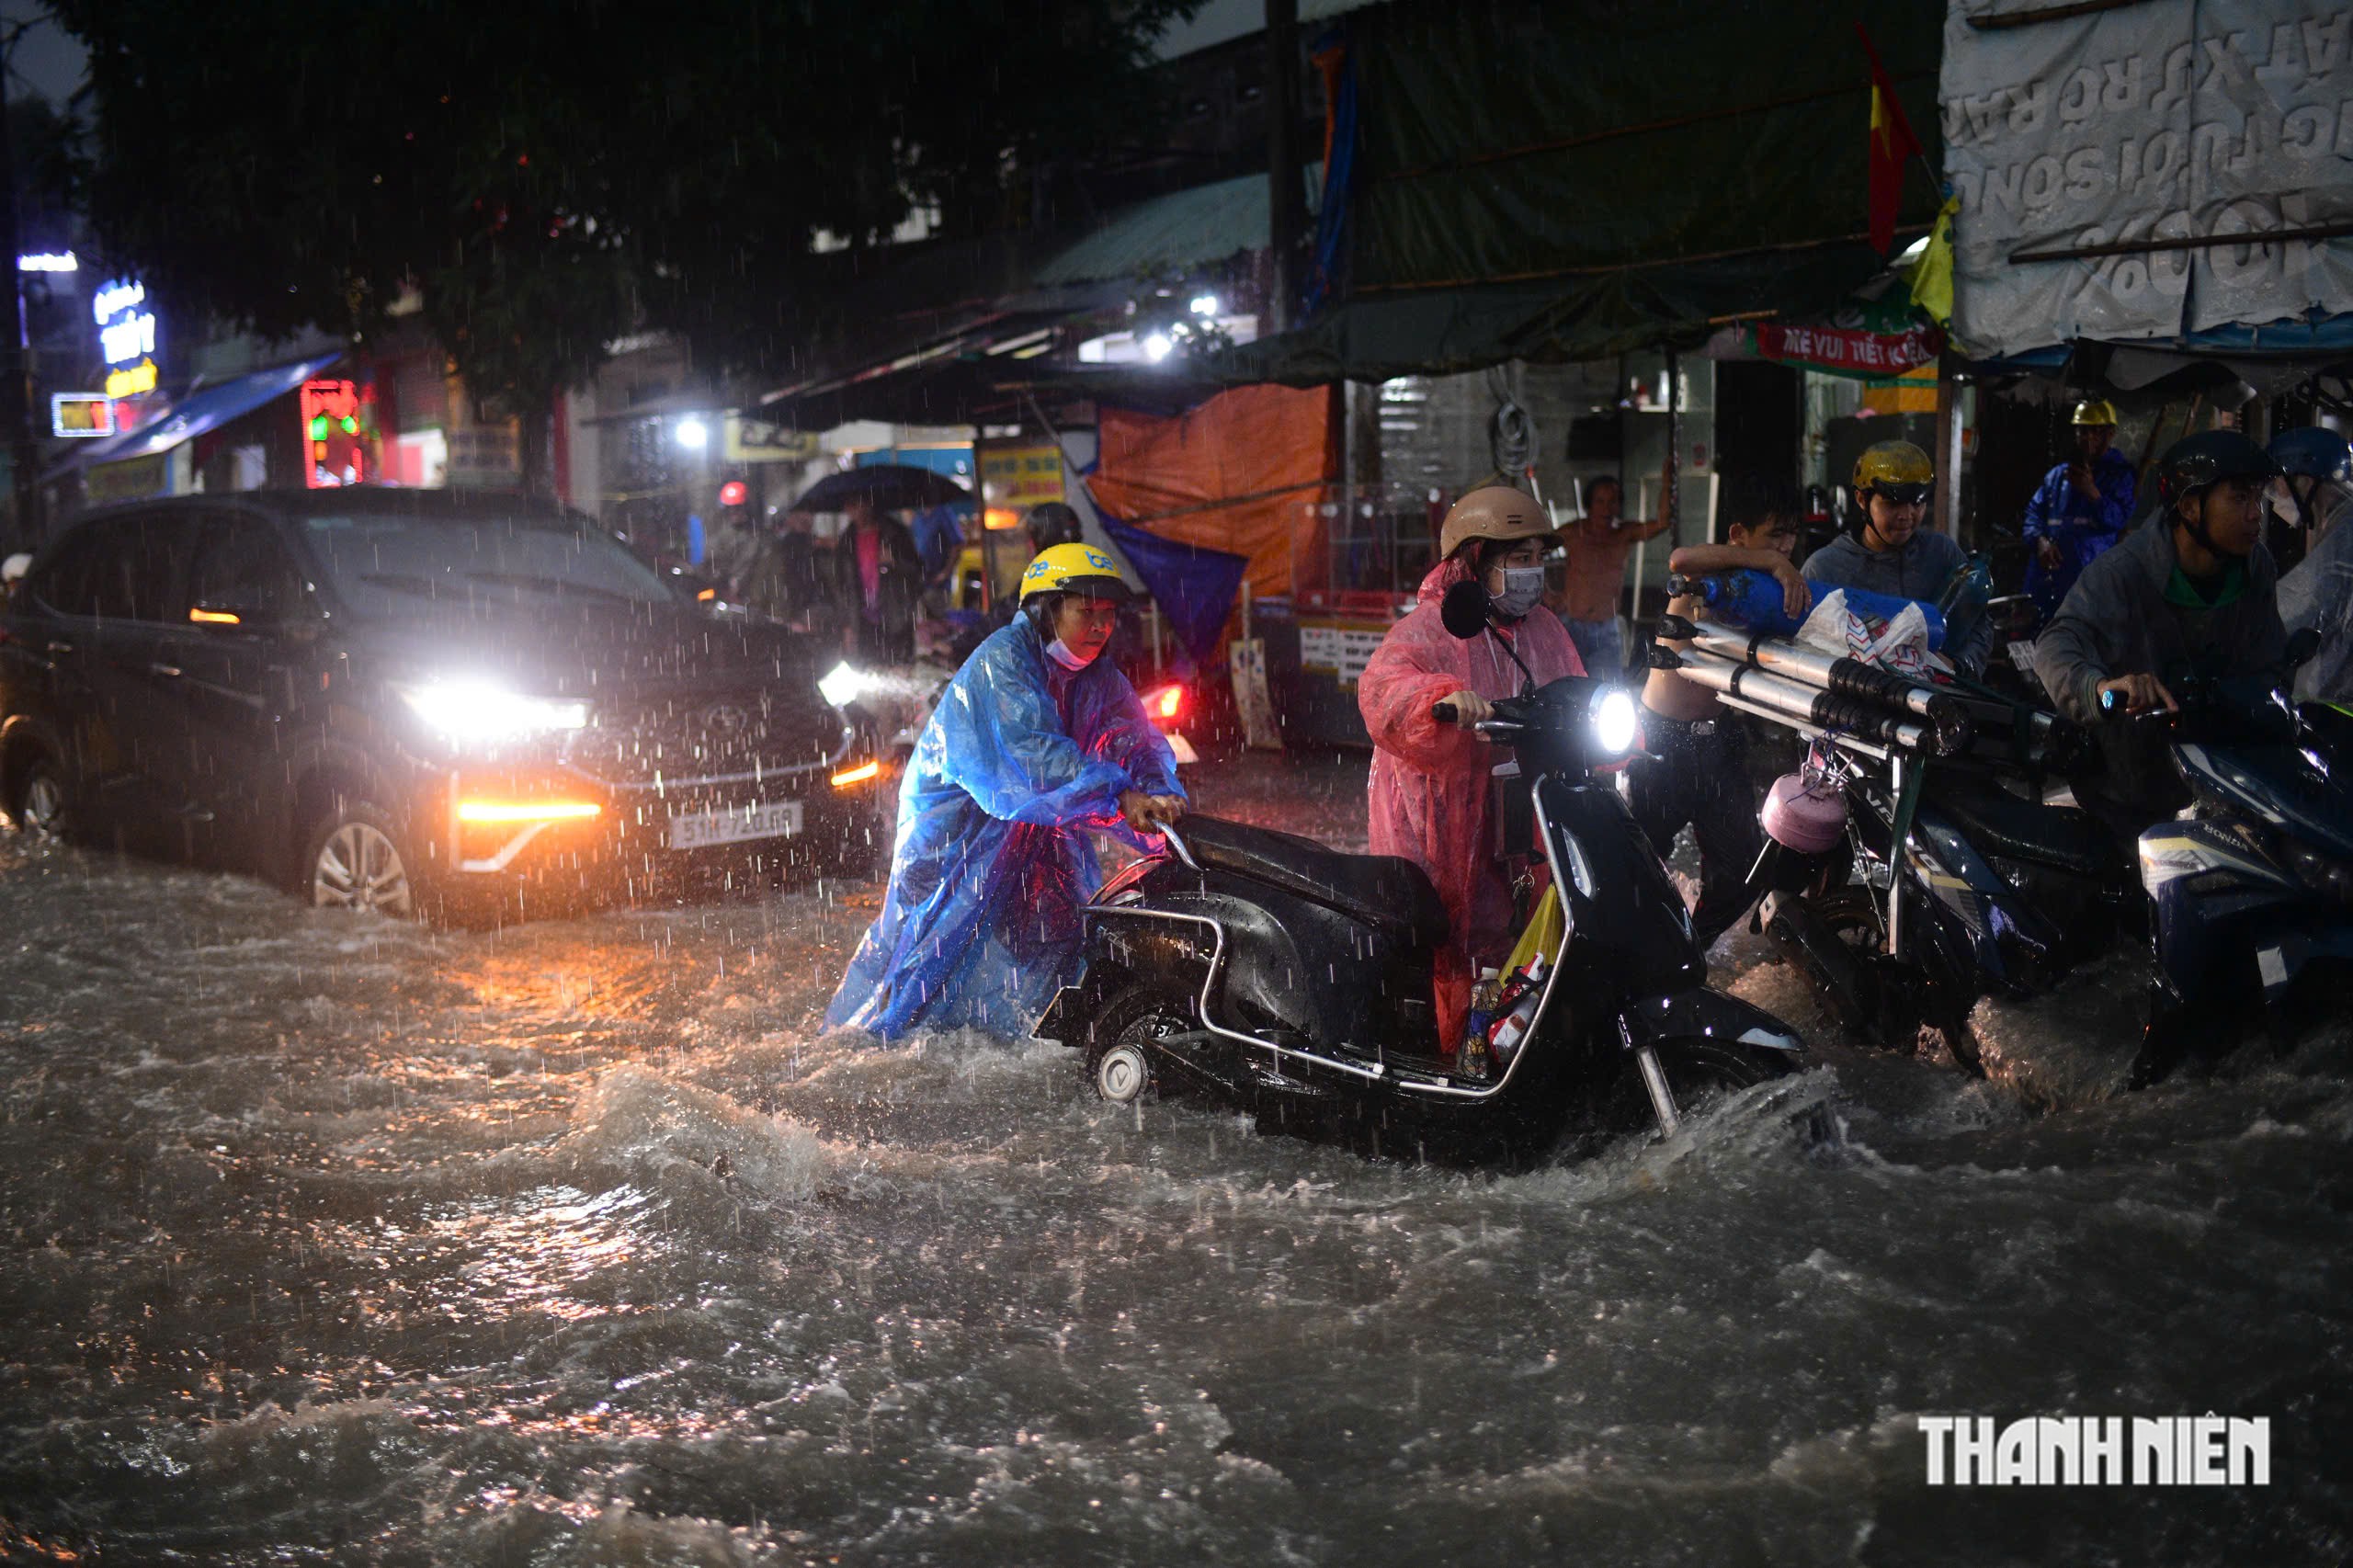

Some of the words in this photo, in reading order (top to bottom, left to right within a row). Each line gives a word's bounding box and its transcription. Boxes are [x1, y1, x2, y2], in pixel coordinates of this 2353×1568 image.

[2075, 194, 2308, 300] 100%
[1813, 334, 1844, 360] VUI
[1085, 551, 1114, 571] be
[1865, 787, 1942, 872] VAIO
